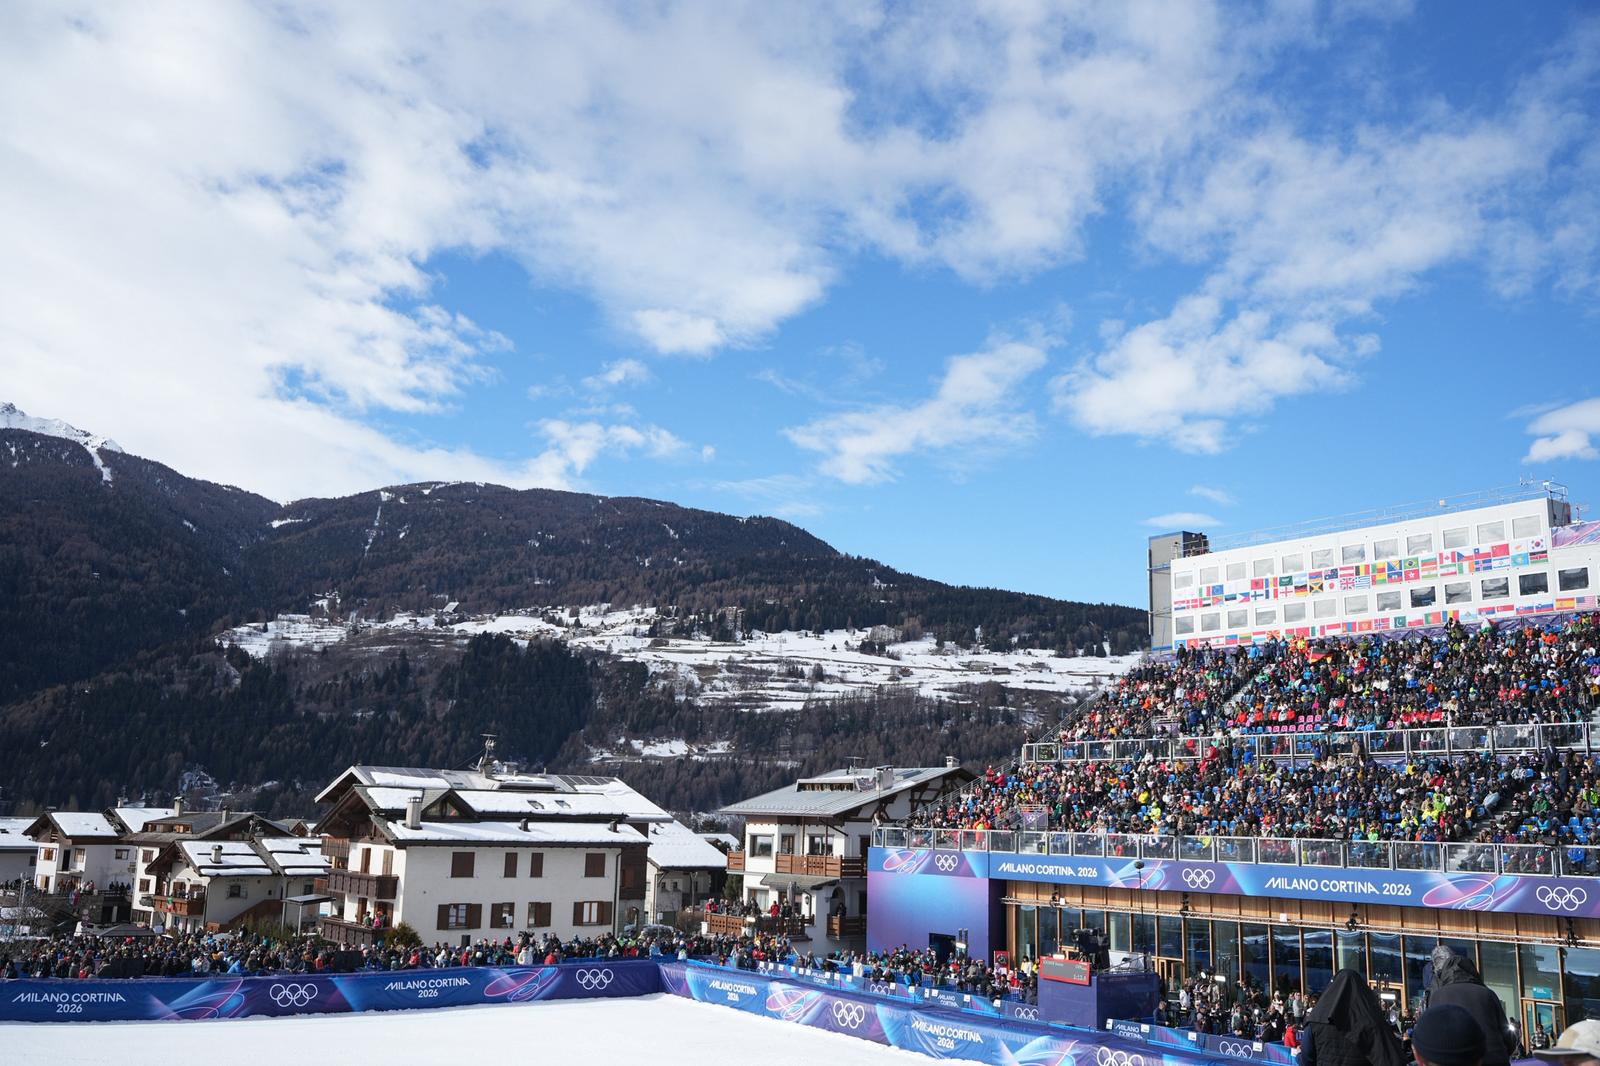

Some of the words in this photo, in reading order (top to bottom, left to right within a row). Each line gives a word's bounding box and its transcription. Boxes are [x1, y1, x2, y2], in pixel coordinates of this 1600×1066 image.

[998, 862, 1035, 875] MILANO
[1036, 865, 1076, 877] CORTINA
[1077, 867, 1098, 878] 2026
[1265, 877, 1318, 891] MILANO
[1320, 880, 1379, 895] CORTINA
[1382, 883, 1412, 896] 2026
[385, 981, 427, 991] MILANO
[428, 977, 471, 988] CORTINA
[709, 979, 733, 992] MILANO
[733, 984, 757, 996] CORTINA
[12, 992, 70, 1003] MILANO
[71, 992, 126, 1002] CORTINA
[418, 989, 439, 998] 2026
[727, 991, 740, 1001] 2026
[937, 994, 956, 1002] MILANO
[56, 1003, 83, 1013] 2026
[940, 1000, 959, 1008] CORTINA
[912, 1020, 946, 1036] MILANO
[946, 1027, 984, 1044] CORTINA
[1115, 1023, 1140, 1033] MILANO
[937, 1037, 955, 1049] 2026
